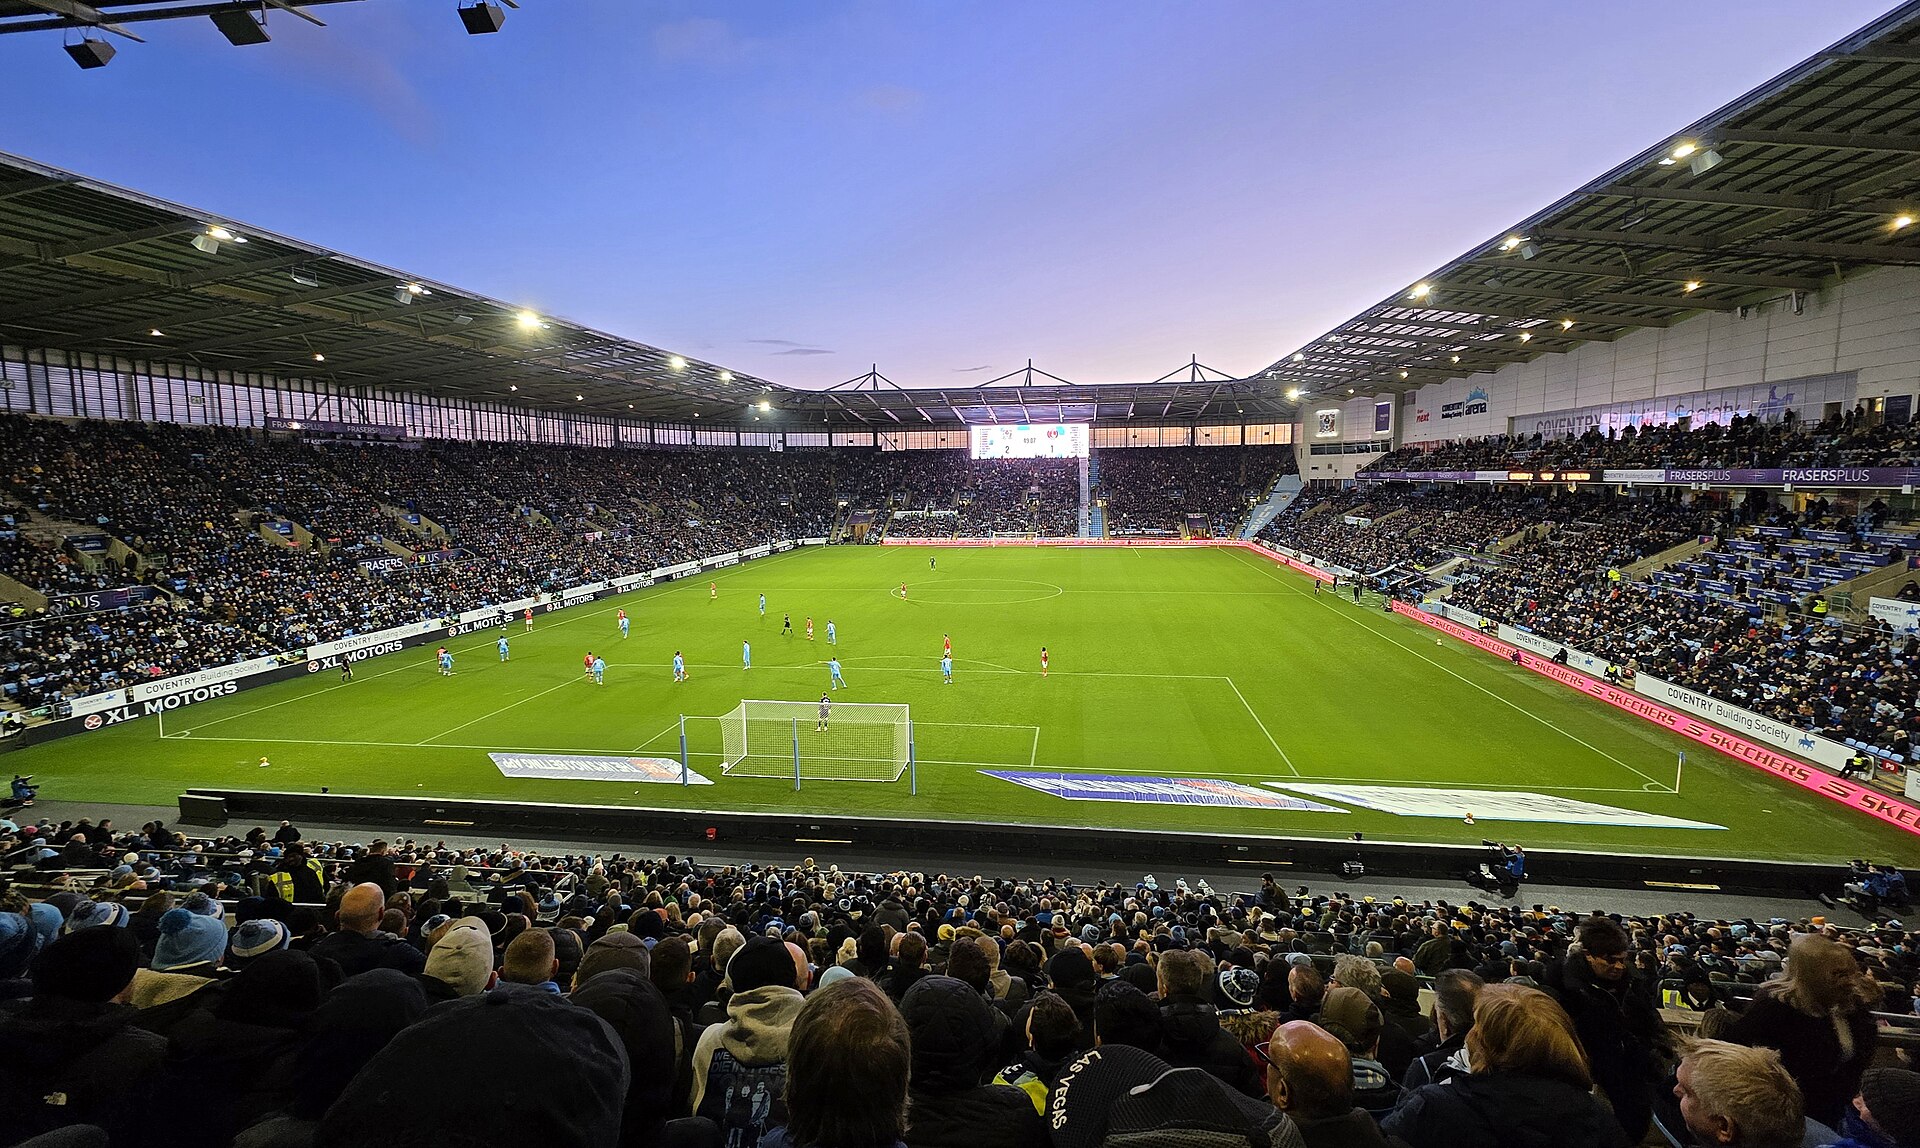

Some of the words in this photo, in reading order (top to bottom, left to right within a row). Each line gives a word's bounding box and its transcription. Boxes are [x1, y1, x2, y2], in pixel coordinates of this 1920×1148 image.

[1465, 402, 1487, 415] arena
[1005, 445, 1010, 454] 2
[1670, 470, 1731, 481] FRASERSPLUS
[1782, 469, 1870, 482] FRASERSPLUS
[622, 583, 631, 593] XL
[631, 579, 655, 591] MOTORS
[552, 601, 564, 611] XL
[564, 593, 595, 608] MOTORS
[1872, 603, 1903, 612] COVENTRY
[1401, 605, 1426, 622] SKECHERS
[333, 635, 372, 650] COVENTRY
[374, 630, 398, 642] Building
[399, 626, 419, 639] Society
[458, 623, 473, 635] XL
[1435, 620, 1466, 638] SKECHERS
[1515, 632, 1542, 648] COVENTRY
[322, 656, 342, 670] XL
[347, 641, 403, 663] MOTORS
[146, 676, 197, 694] COVENTRY
[200, 666, 233, 682] Building
[234, 660, 261, 676] Society
[1534, 661, 1585, 687] SKECHERS
[106, 706, 139, 725] XL
[144, 681, 238, 716] MOTORS
[1606, 690, 1677, 726] SKECHERS
[1667, 687, 1713, 711] COVENTRY
[1716, 703, 1753, 729] Building
[1754, 717, 1791, 744] Society
[1708, 732, 1812, 782] SKECHERS
[1069, 1050, 1102, 1073] LAS
[1052, 1074, 1075, 1130] VEGAS
